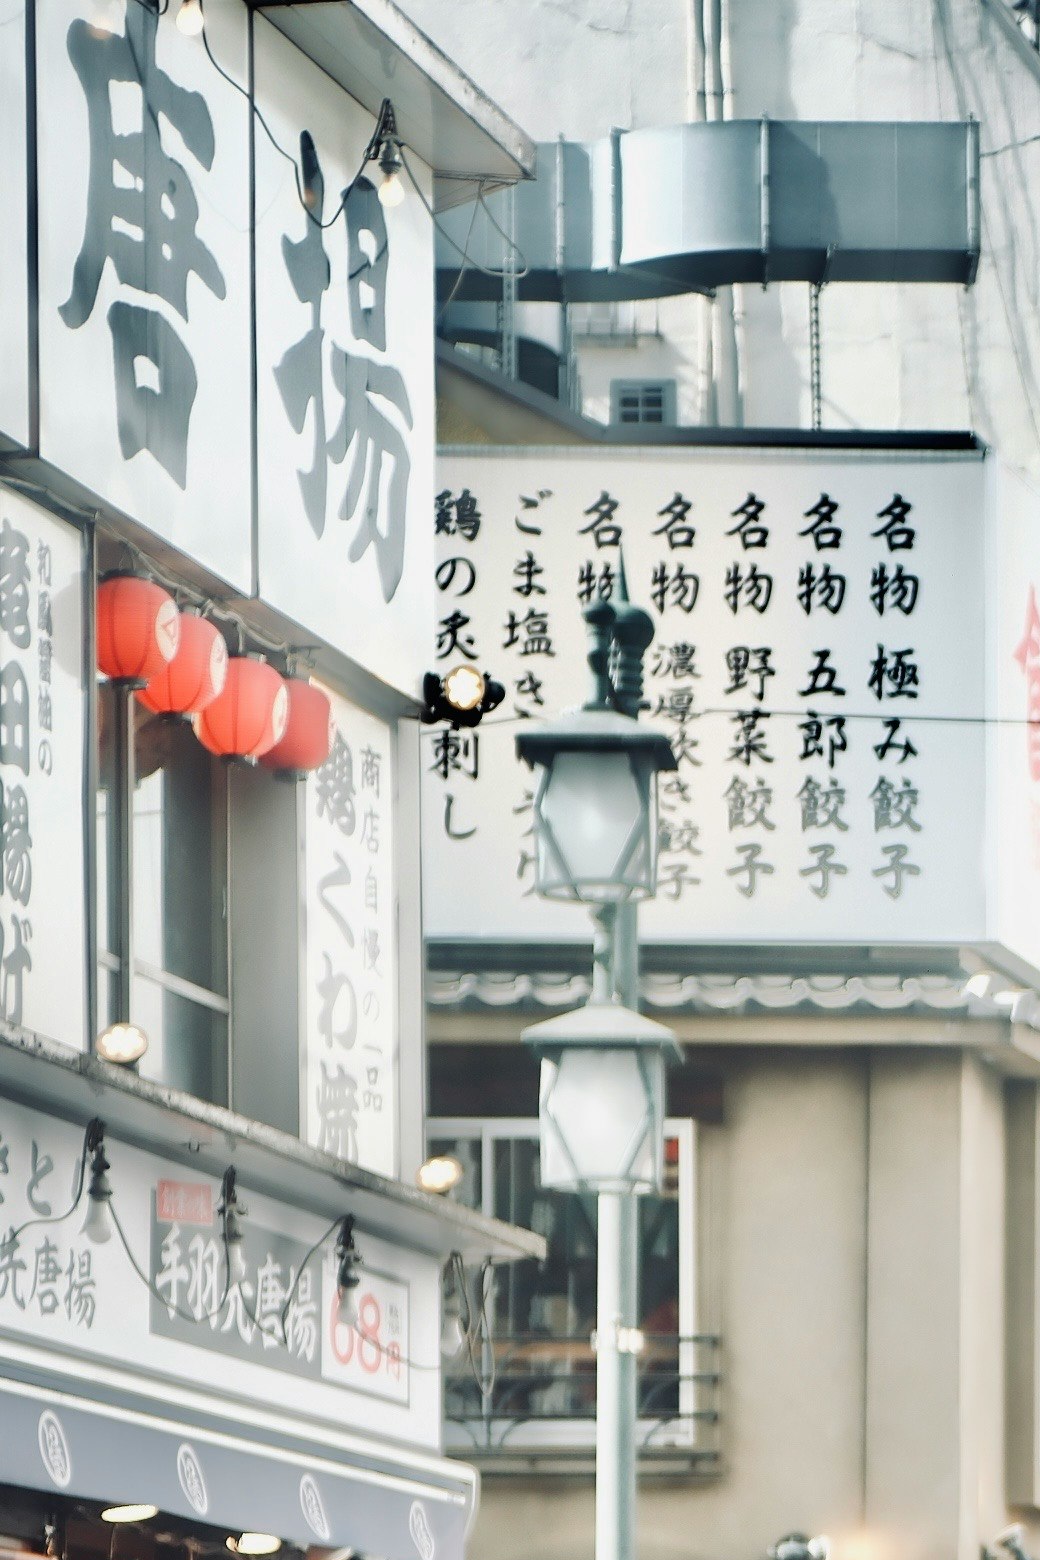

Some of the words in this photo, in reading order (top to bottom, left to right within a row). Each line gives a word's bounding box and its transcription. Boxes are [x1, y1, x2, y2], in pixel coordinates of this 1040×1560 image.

[57, 0, 413, 603] 唐揚
[430, 489, 483, 842] 鶏の炙刺し
[359, 745, 384, 1115] 商店自慢の一品
